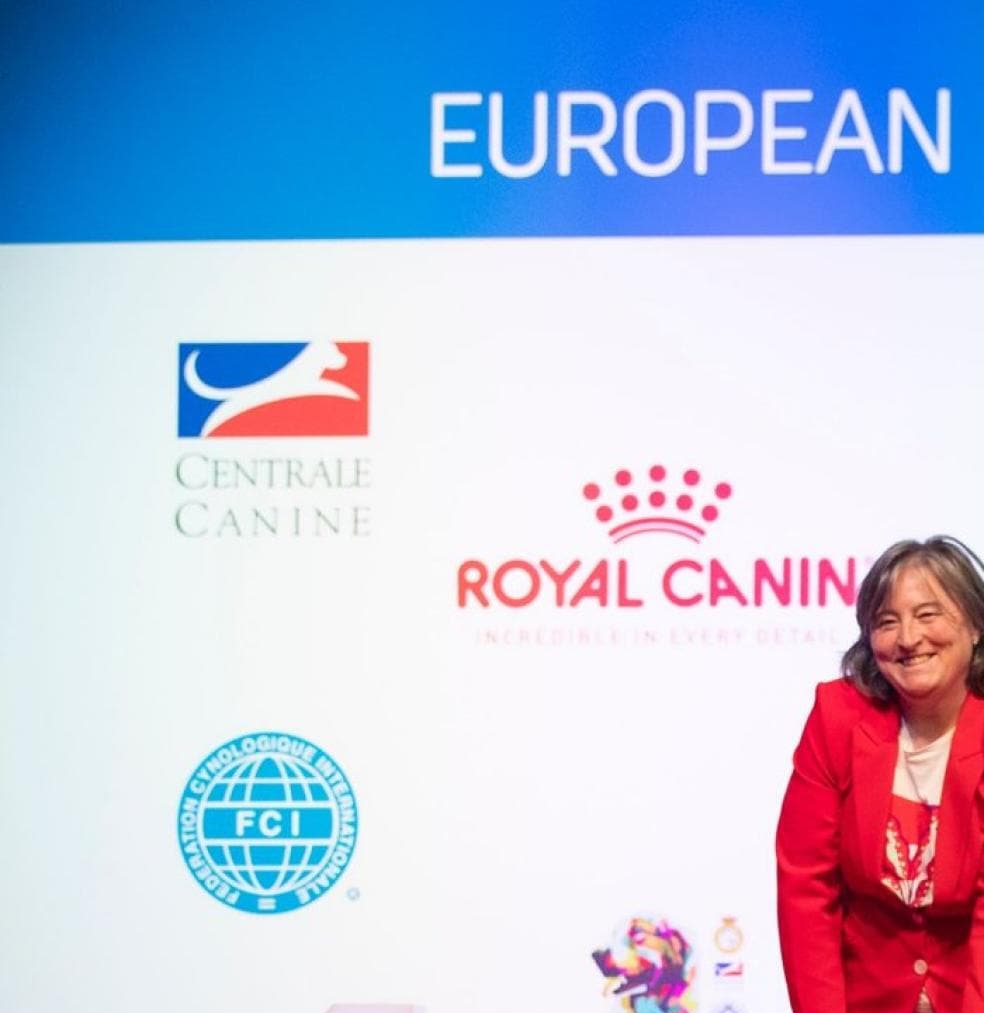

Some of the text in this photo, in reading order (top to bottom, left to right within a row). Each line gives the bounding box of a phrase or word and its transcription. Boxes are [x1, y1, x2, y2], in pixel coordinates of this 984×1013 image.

[430, 88, 953, 178] EUROPEAN
[175, 451, 372, 490] CENTRALE
[175, 499, 372, 538] CANINE
[457, 556, 857, 609] ROYAL CANIN
[181, 735, 356, 905] FEDERATION CYNOLOGIQUE INTERNATIONALE
[235, 809, 300, 838] FCI
